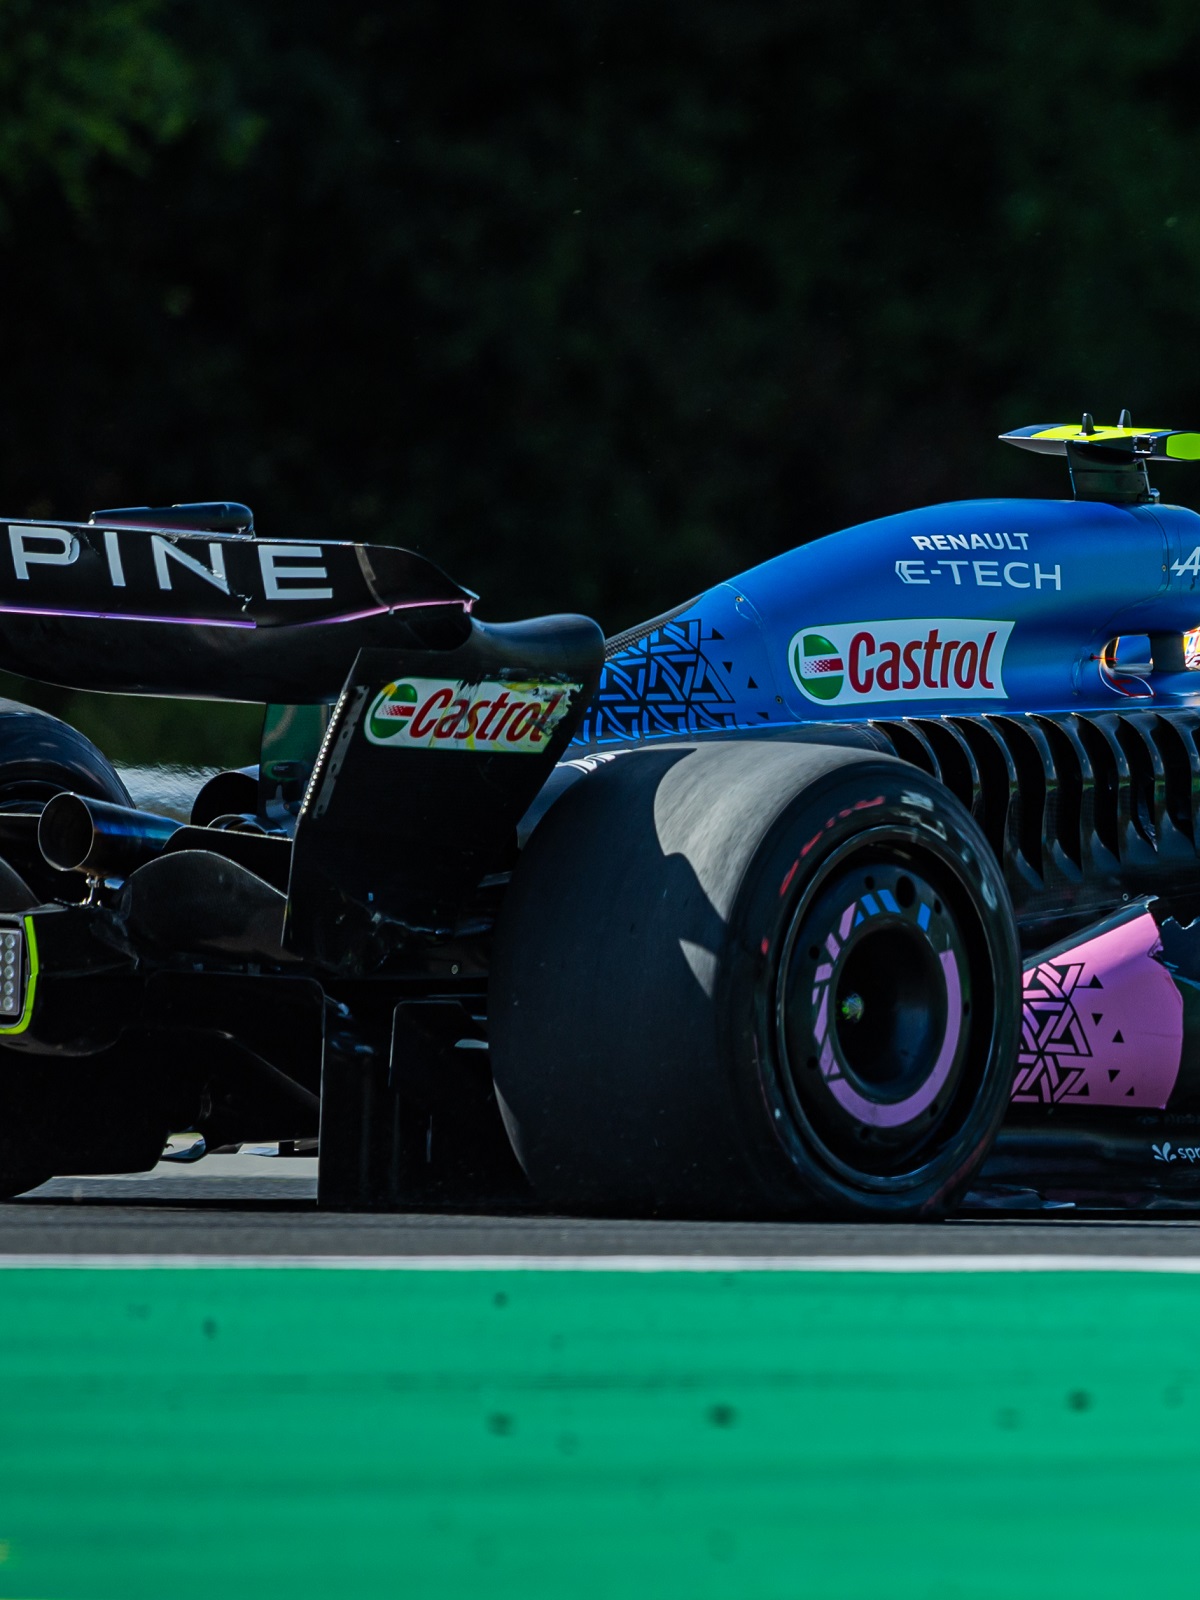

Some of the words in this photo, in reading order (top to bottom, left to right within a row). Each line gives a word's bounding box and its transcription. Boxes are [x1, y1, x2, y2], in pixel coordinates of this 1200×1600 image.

[911, 532, 1029, 551] RENAULT
[895, 560, 1062, 591] E-TECH
[849, 629, 998, 694] Castrol
[409, 688, 564, 742] Castrol
